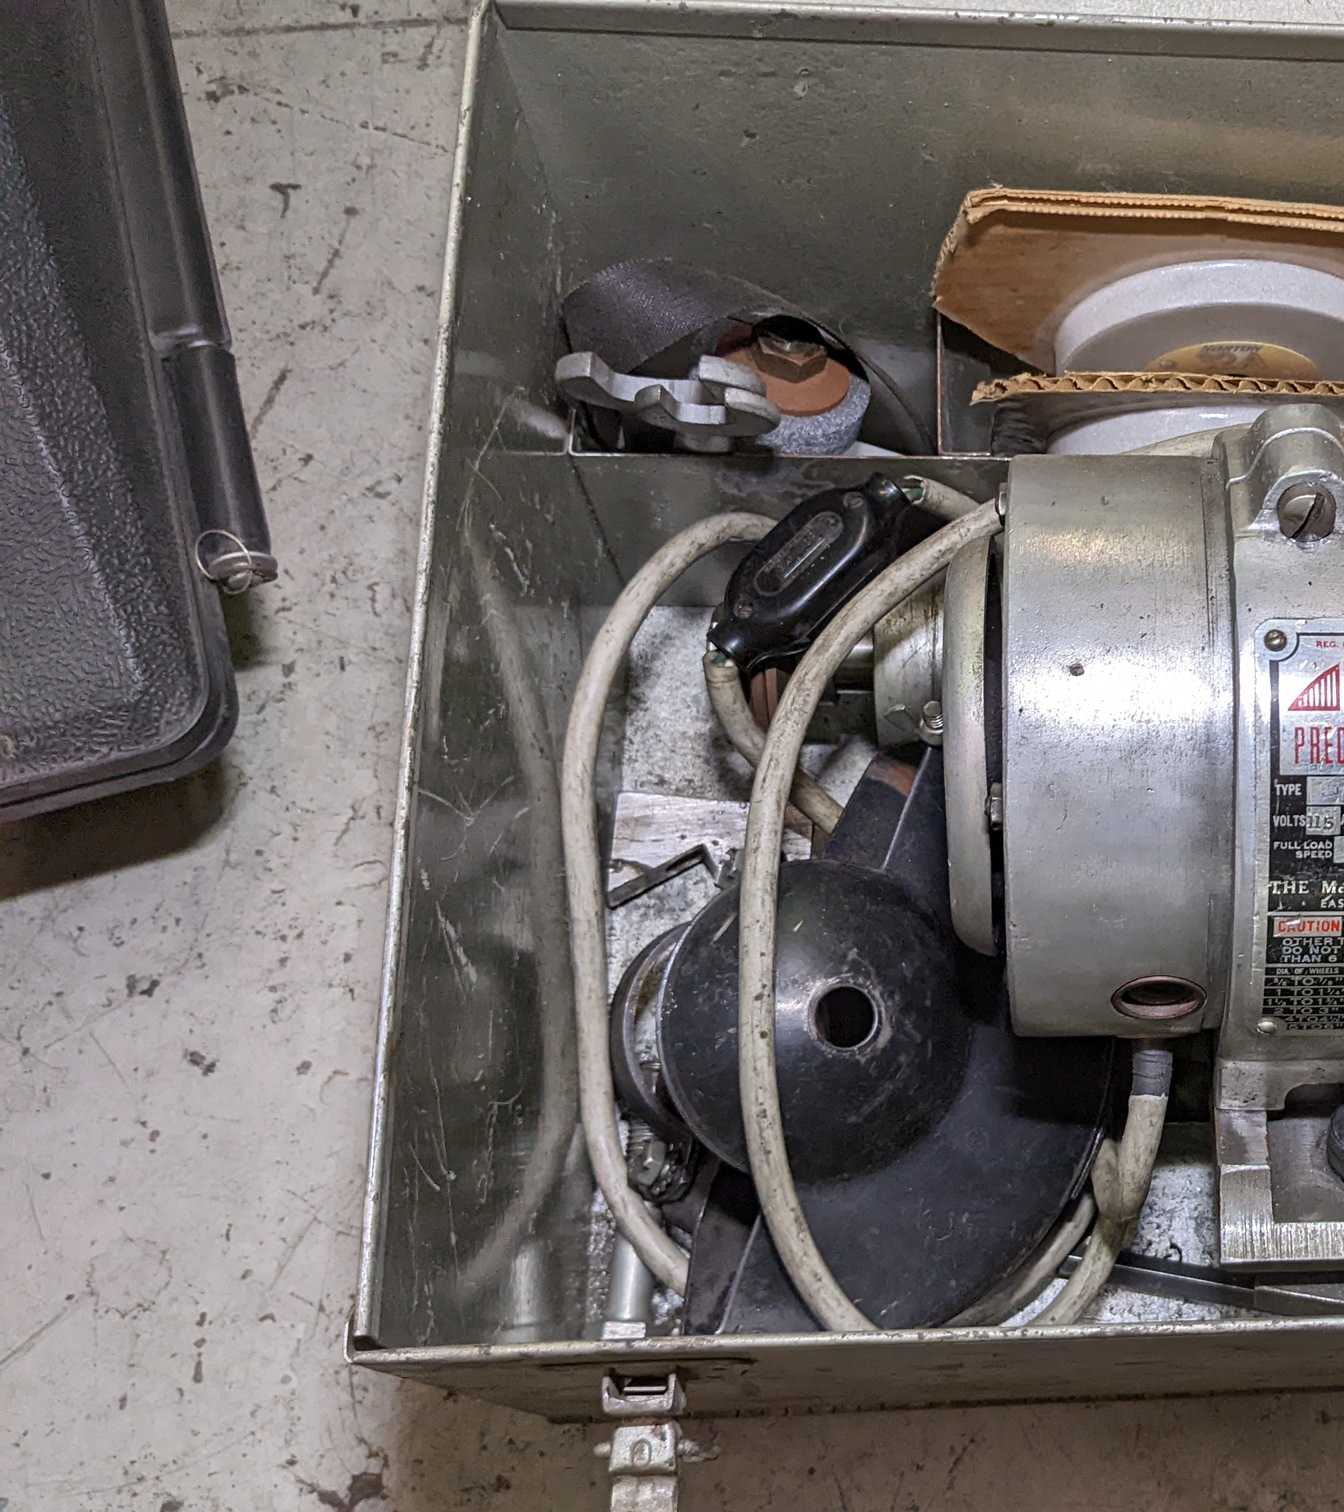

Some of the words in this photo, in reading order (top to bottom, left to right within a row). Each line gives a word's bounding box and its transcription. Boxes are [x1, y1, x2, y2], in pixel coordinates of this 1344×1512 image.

[1275, 784, 1302, 796] TYPE
[1273, 815, 1306, 827] VOLTS
[1307, 815, 1334, 830] 115
[1273, 841, 1302, 849] FULL
[1304, 841, 1333, 849] LOAD
[1295, 850, 1333, 859] SPEED
[1271, 880, 1310, 894] THE
[1278, 920, 1340, 932] CAUTION
[1282, 937, 1333, 946] OTHER
[1282, 946, 1302, 955] DO
[1309, 946, 1341, 954] NOT
[1281, 954, 1321, 963] THAN
[1328, 954, 1337, 962] 6
[1291, 987, 1314, 996] TO
